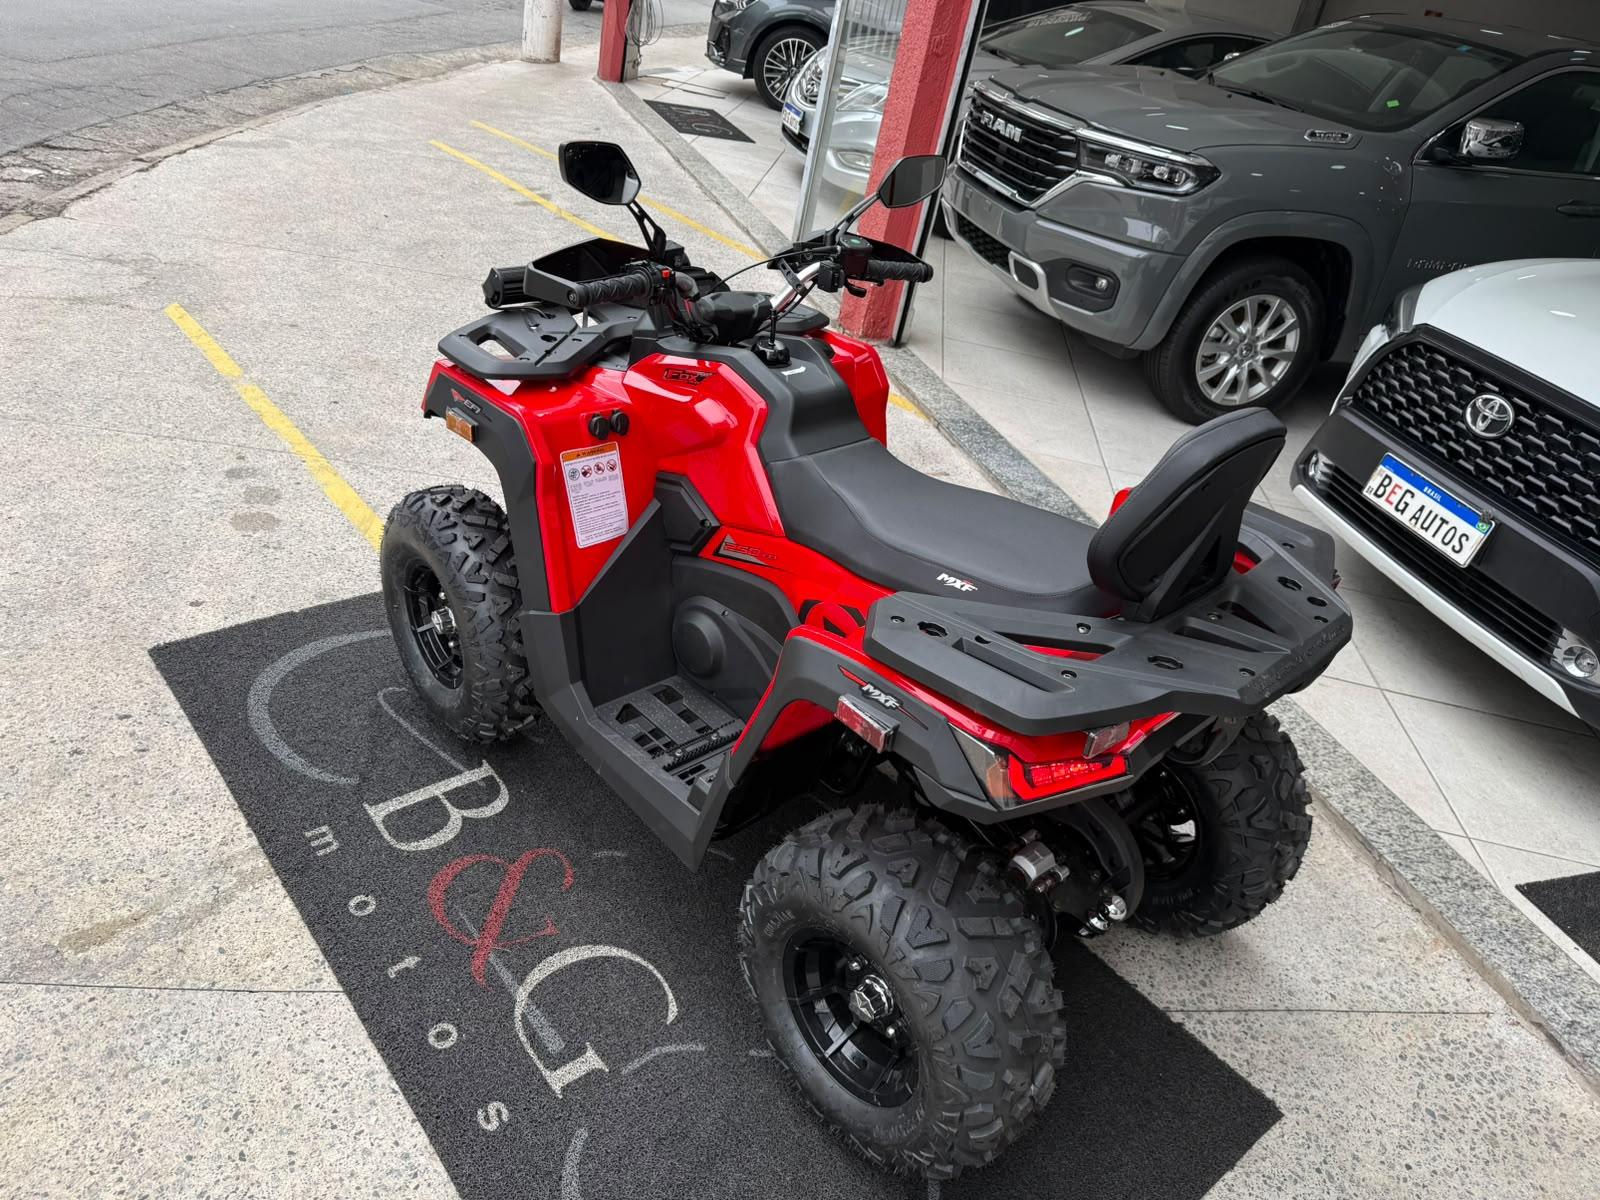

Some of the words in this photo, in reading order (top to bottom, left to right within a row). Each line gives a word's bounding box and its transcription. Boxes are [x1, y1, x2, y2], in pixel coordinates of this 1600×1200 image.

[981, 110, 1022, 142] RAM
[1423, 486, 1441, 502] BRASIL
[1373, 474, 1415, 515] BEG
[1409, 505, 1469, 554] AUTOS
[936, 573, 978, 591] MXF
[862, 683, 900, 708] MXF
[304, 824, 511, 1132] motos
